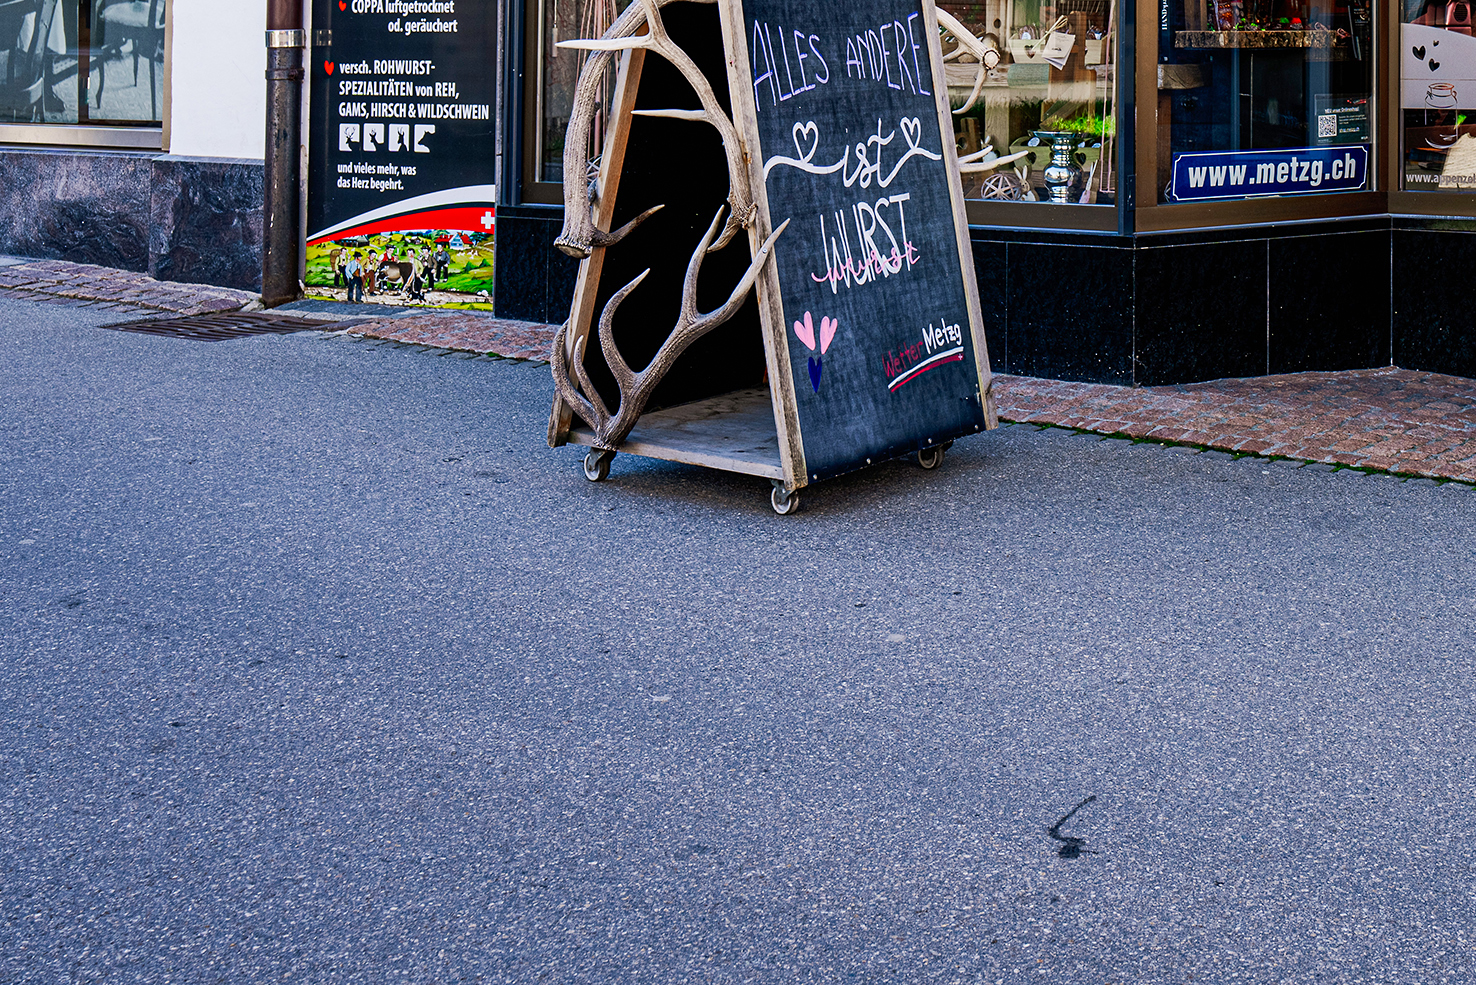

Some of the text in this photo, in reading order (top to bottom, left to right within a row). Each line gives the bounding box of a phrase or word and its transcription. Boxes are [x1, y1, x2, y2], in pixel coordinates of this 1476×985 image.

[351, 0, 455, 17] COPPA luftgetrocknet
[388, 18, 458, 36] od. geräuchert
[339, 60, 436, 75] versch. ROHWURST-
[754, 11, 931, 112] ALLES ANDERE
[338, 78, 460, 99] SPEZIALITÄTEN von REH,
[338, 102, 489, 120] GAMS, HIRSCH & WILDSCHWEIN
[337, 162, 417, 176] und vieles mehr, was
[1188, 153, 1356, 189] www.metzg.ch
[337, 176, 404, 192] das Herz begehrt.
[820, 193, 911, 295] WURST
[882, 318, 963, 378] Wetter Metzg
